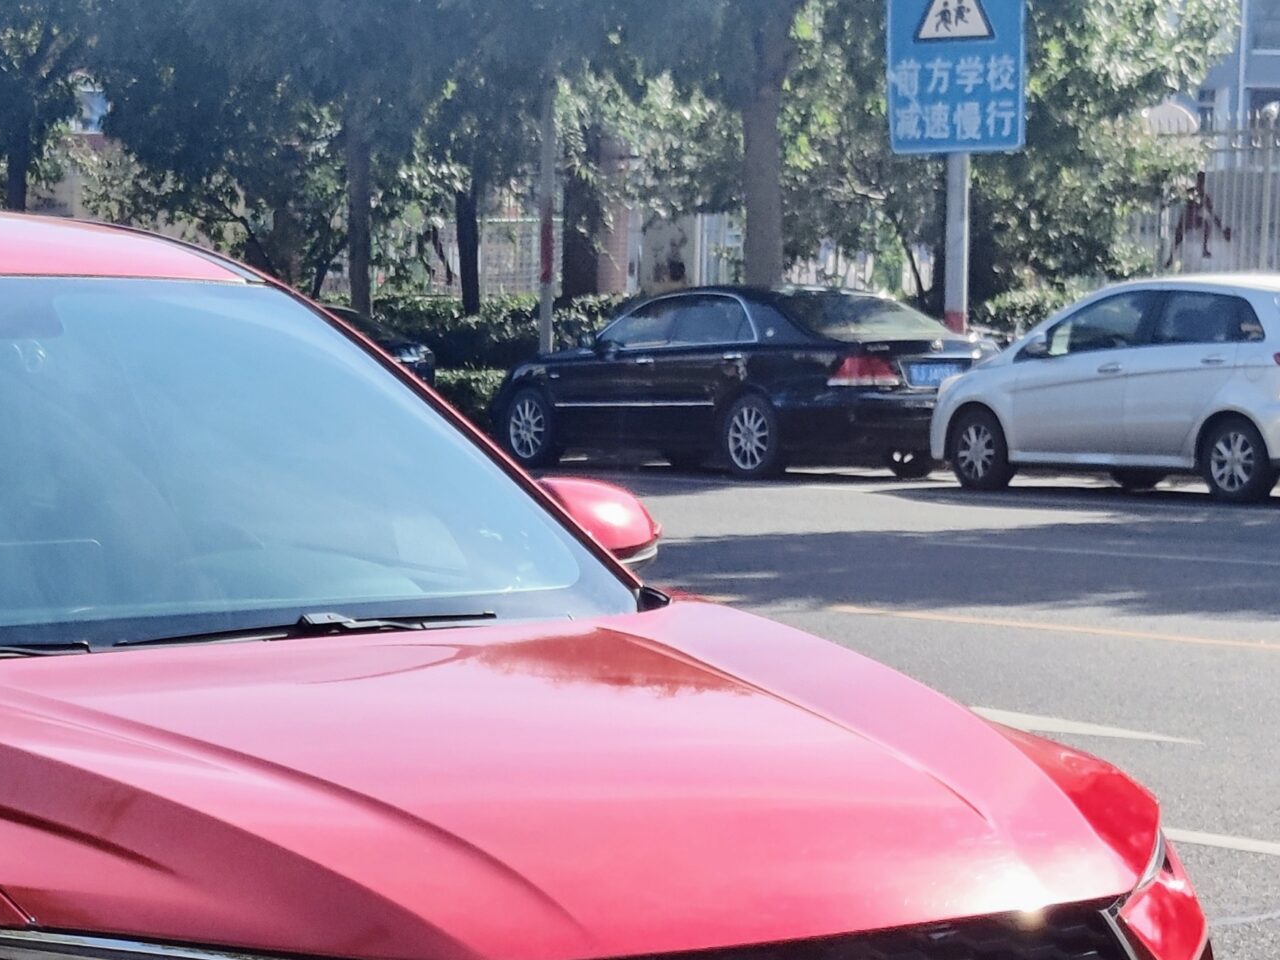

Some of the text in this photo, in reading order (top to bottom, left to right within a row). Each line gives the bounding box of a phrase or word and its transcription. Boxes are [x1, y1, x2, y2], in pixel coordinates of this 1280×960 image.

[896, 55, 1016, 96] 前方学校
[895, 101, 1016, 140] 减速慢行
